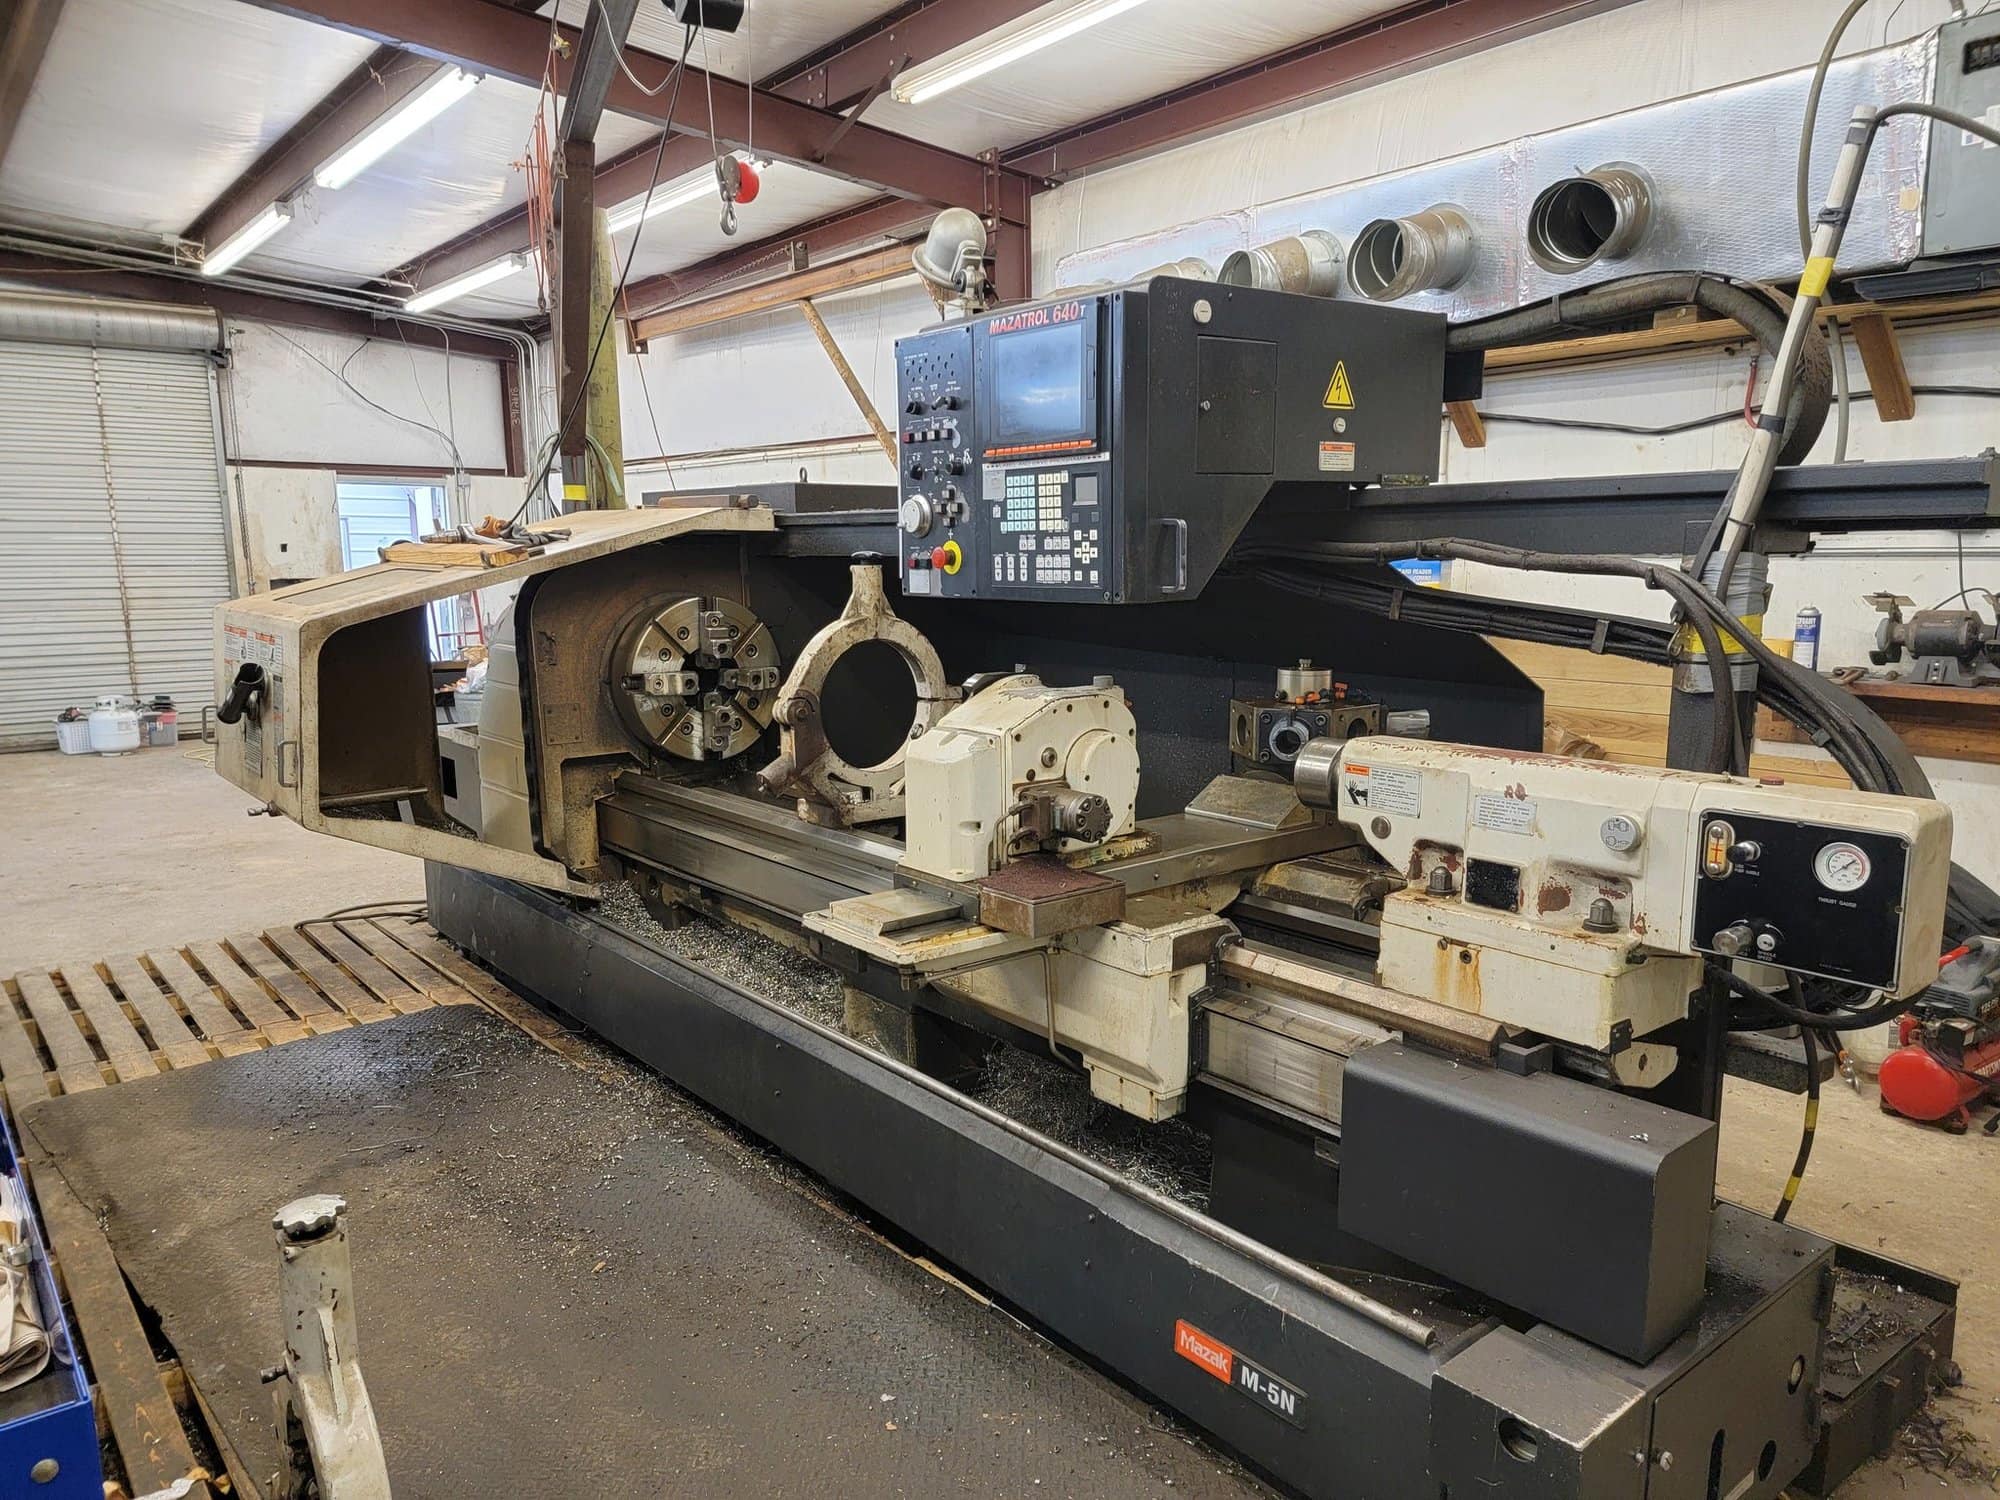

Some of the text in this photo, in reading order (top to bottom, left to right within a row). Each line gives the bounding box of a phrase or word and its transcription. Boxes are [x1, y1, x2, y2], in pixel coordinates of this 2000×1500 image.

[989, 308, 1050, 335] MAZATROL
[1180, 1329, 1296, 1415] Mazak M-5N
